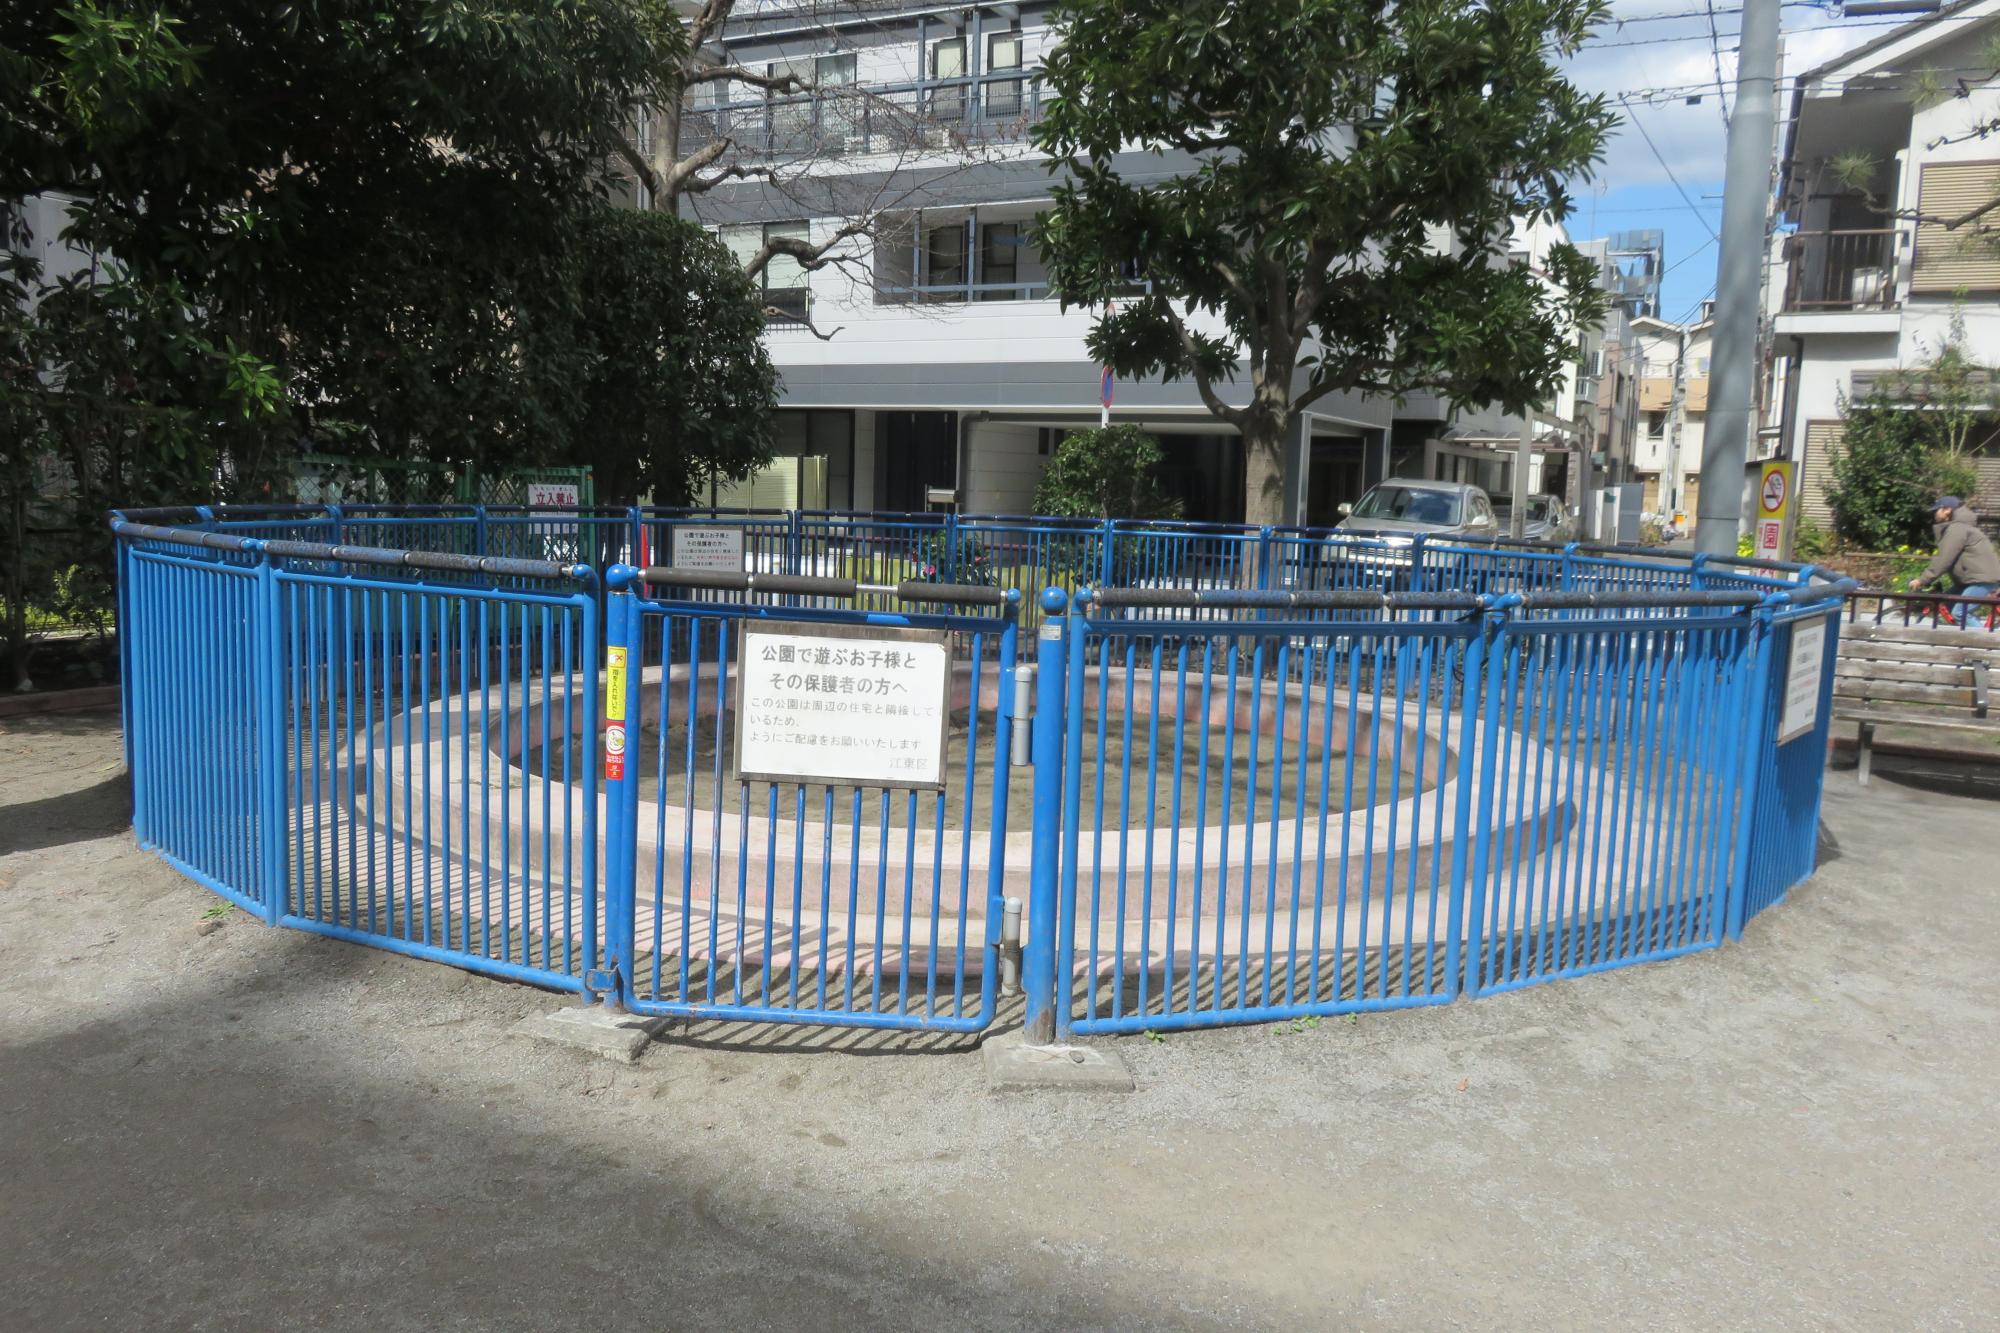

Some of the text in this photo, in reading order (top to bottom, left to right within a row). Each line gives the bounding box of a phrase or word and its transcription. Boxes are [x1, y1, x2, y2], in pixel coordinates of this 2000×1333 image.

[761, 645, 917, 669] 公園で遊ぶお子様と
[769, 673, 908, 695] その保護者の方へ
[751, 697, 934, 717] この公園は周辺の住宅と隣接して
[750, 731, 921, 750] ようにご配慮をお願いいたします
[889, 757, 928, 770] 江東区
